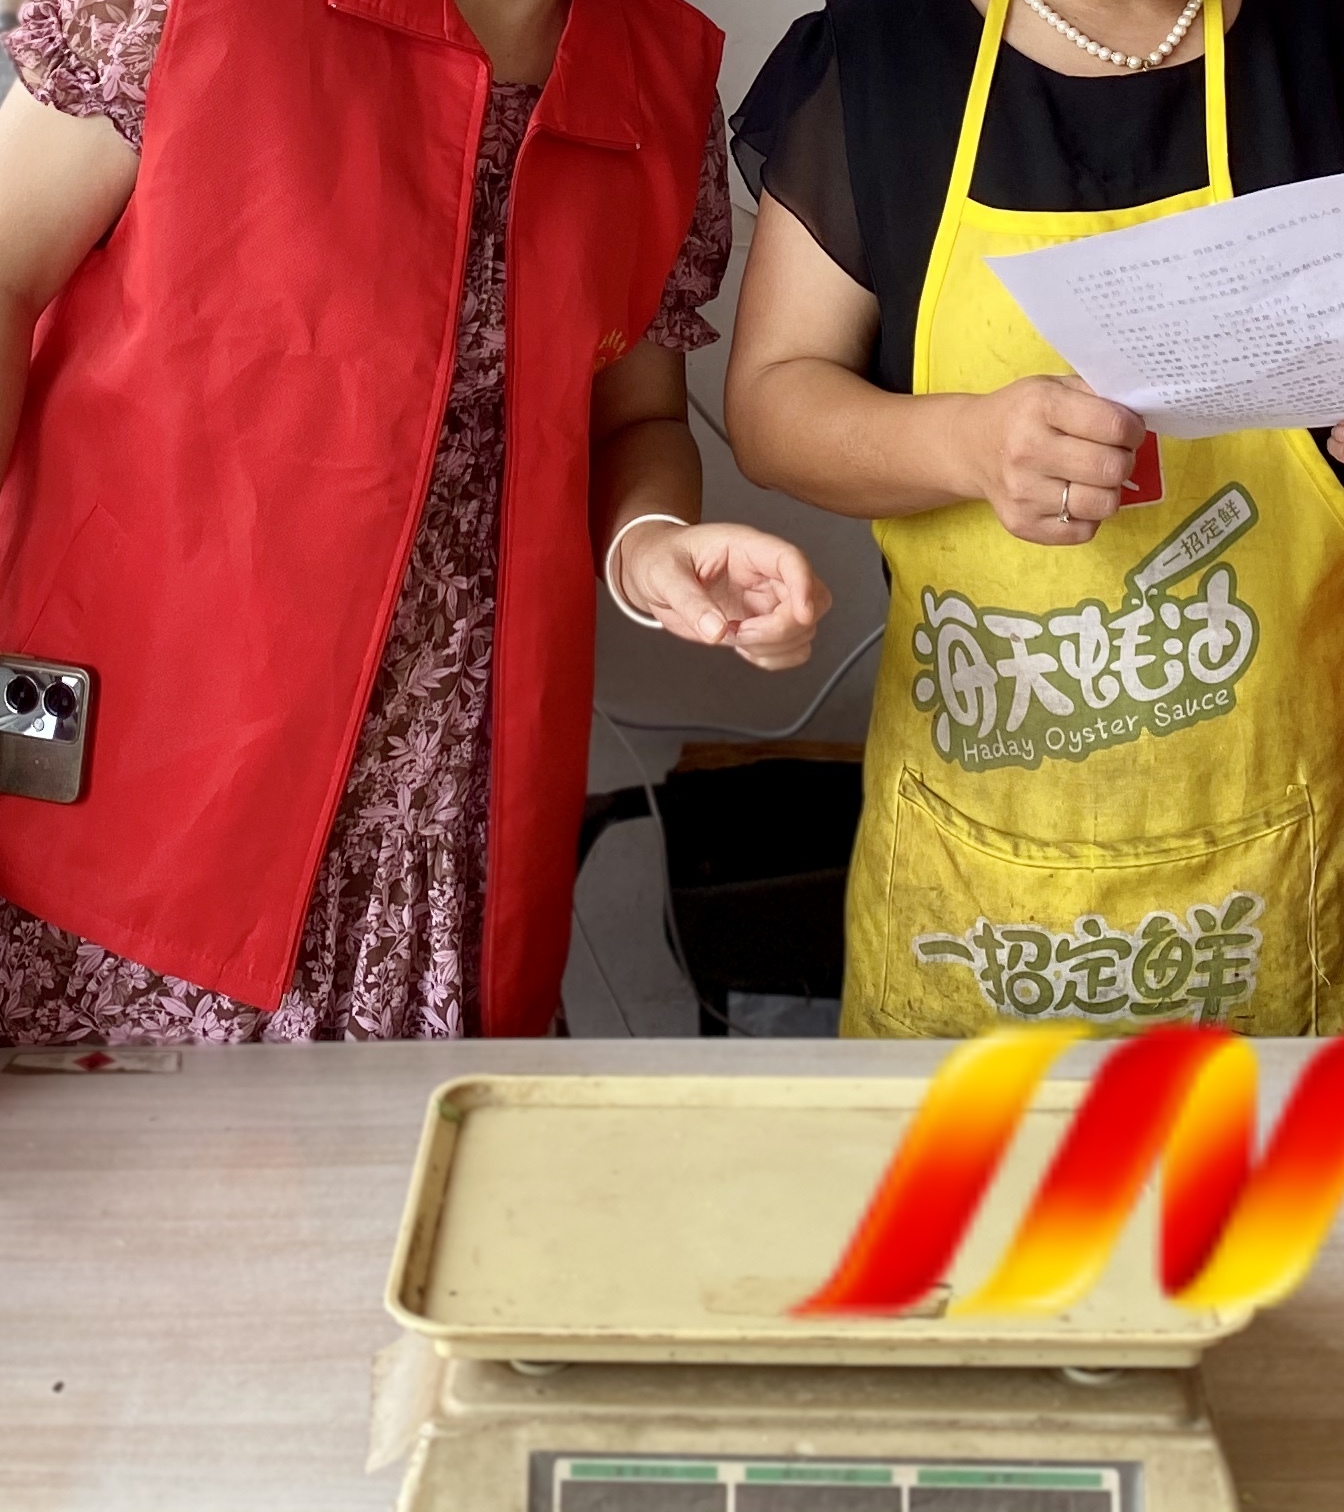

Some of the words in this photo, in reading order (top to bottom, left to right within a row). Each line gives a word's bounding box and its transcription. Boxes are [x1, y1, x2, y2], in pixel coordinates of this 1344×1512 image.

[1162, 498, 1242, 568] 一招定鲜
[915, 569, 1254, 752] 海天蚝油
[963, 735, 1035, 763] Haday
[1045, 716, 1140, 751] Oyster
[1155, 688, 1230, 727] Sauce
[918, 895, 1258, 1027] 一招定鲜
